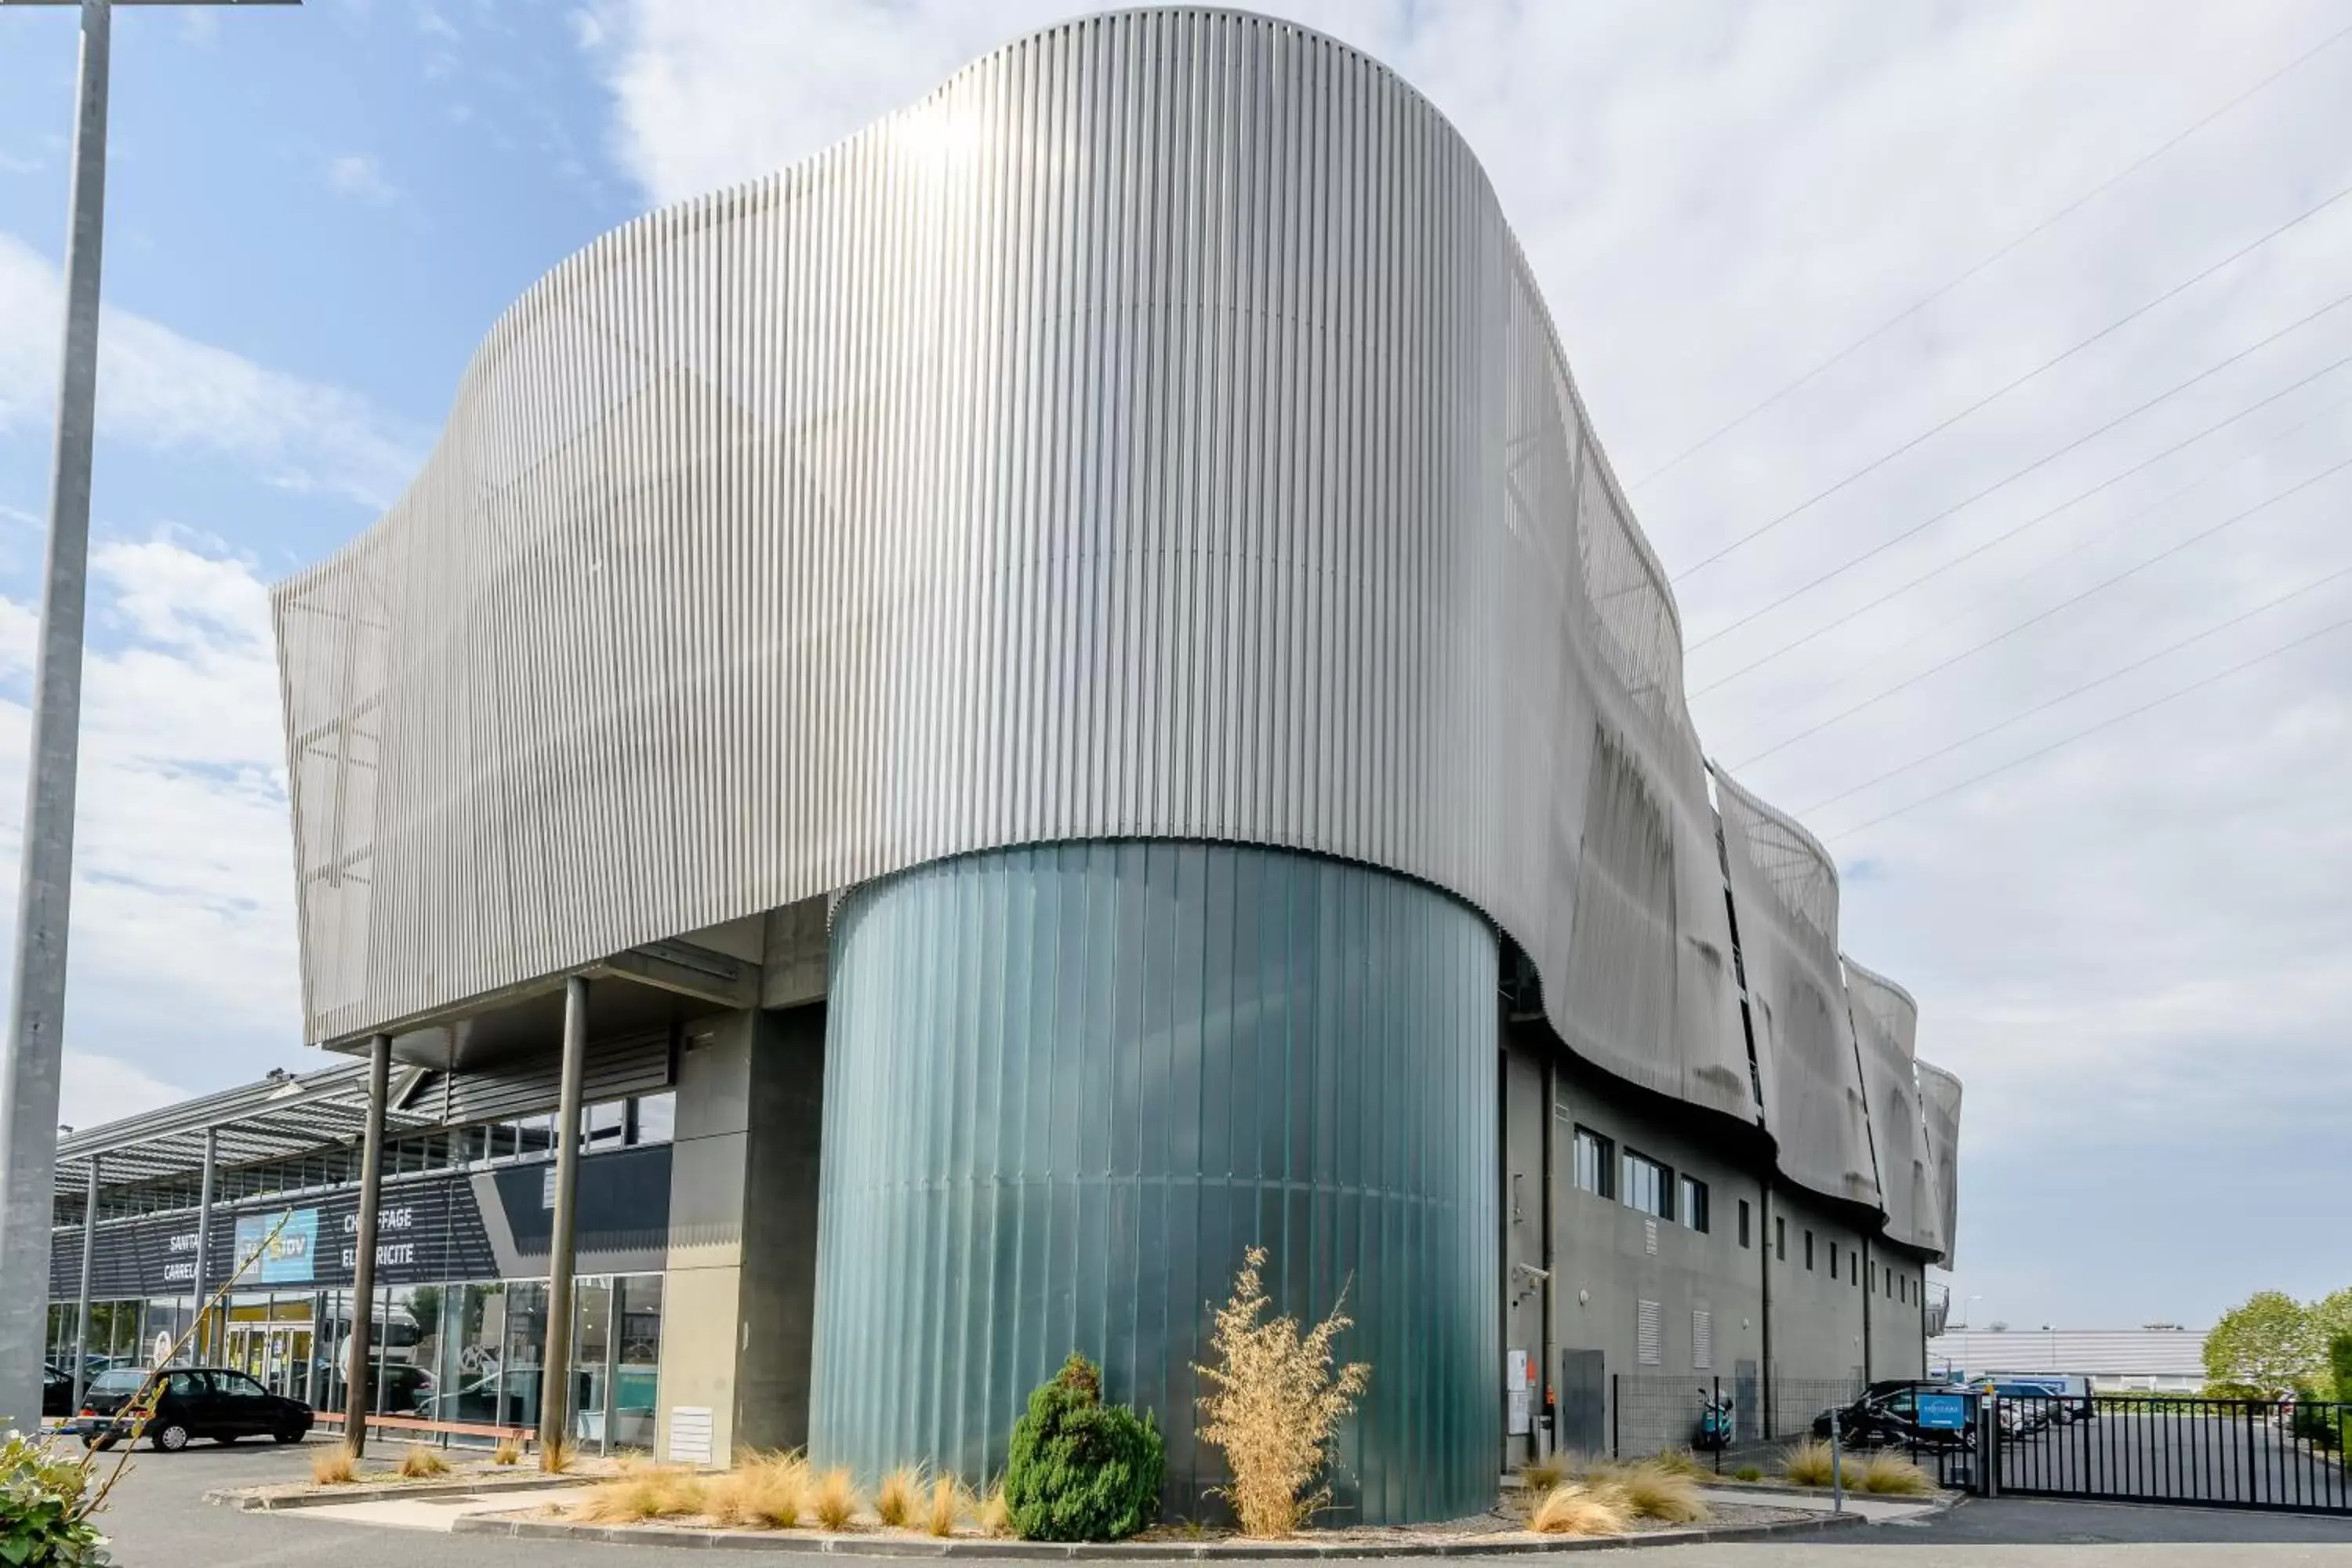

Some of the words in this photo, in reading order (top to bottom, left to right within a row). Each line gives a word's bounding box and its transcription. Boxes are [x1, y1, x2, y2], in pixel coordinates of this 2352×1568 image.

[344, 1207, 412, 1233] CHFAGE
[169, 1231, 212, 1251] SANITAE
[342, 1243, 414, 1269] ELRICITE
[163, 1259, 210, 1280] CARRELAE
